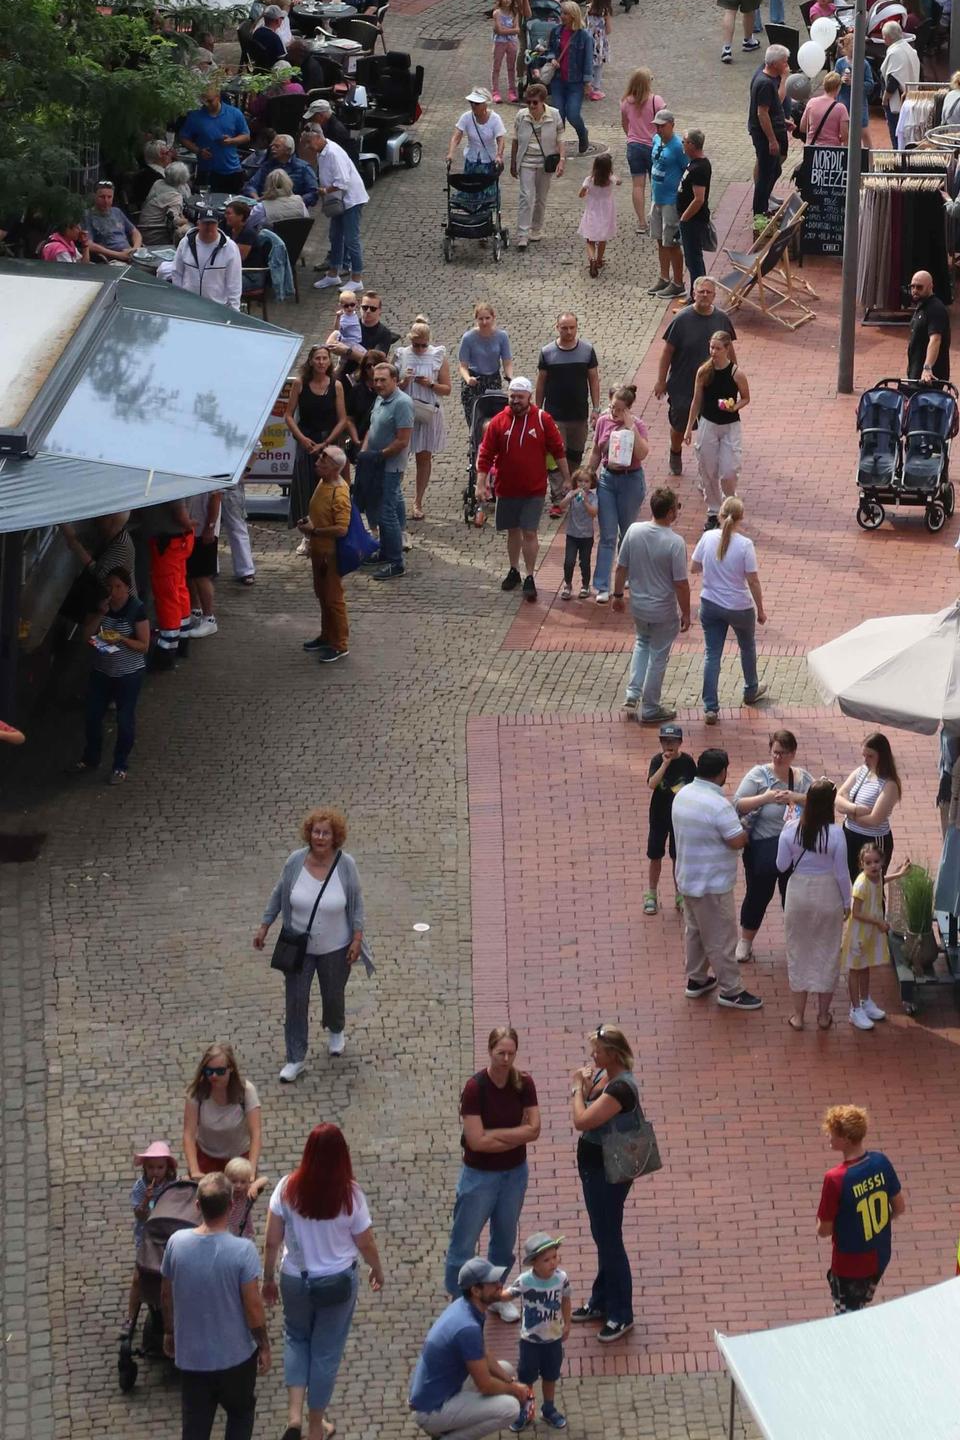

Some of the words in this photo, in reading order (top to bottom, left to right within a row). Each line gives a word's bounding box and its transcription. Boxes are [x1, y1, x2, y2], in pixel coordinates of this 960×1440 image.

[812, 150, 845, 170] NORDIC
[811, 169, 848, 188] BREEZE
[853, 1173, 885, 1198] MESSI
[856, 1190, 889, 1242] 10
